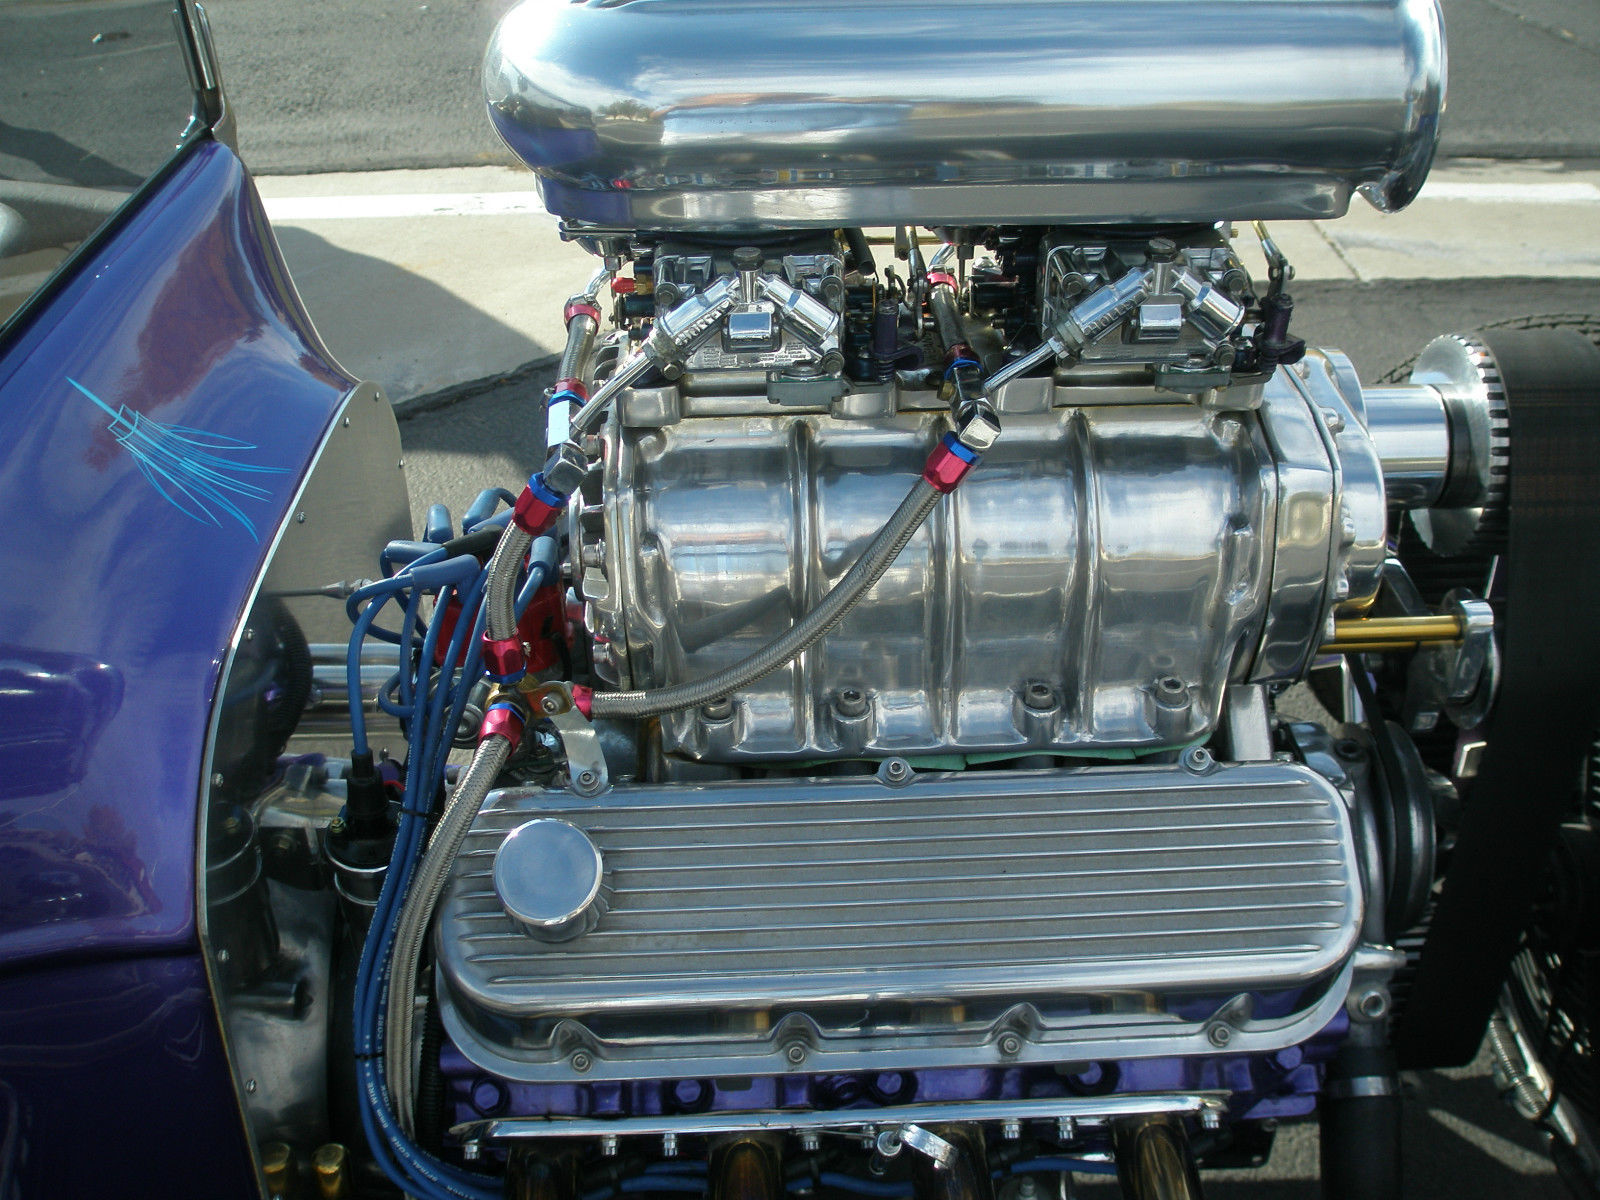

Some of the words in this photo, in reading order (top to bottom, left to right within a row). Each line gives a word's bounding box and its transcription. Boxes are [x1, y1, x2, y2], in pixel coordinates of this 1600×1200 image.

[677, 301, 728, 344] HOLLEY
[1087, 295, 1138, 334] HOLLEY
[367, 1081, 378, 1105] WIRE
